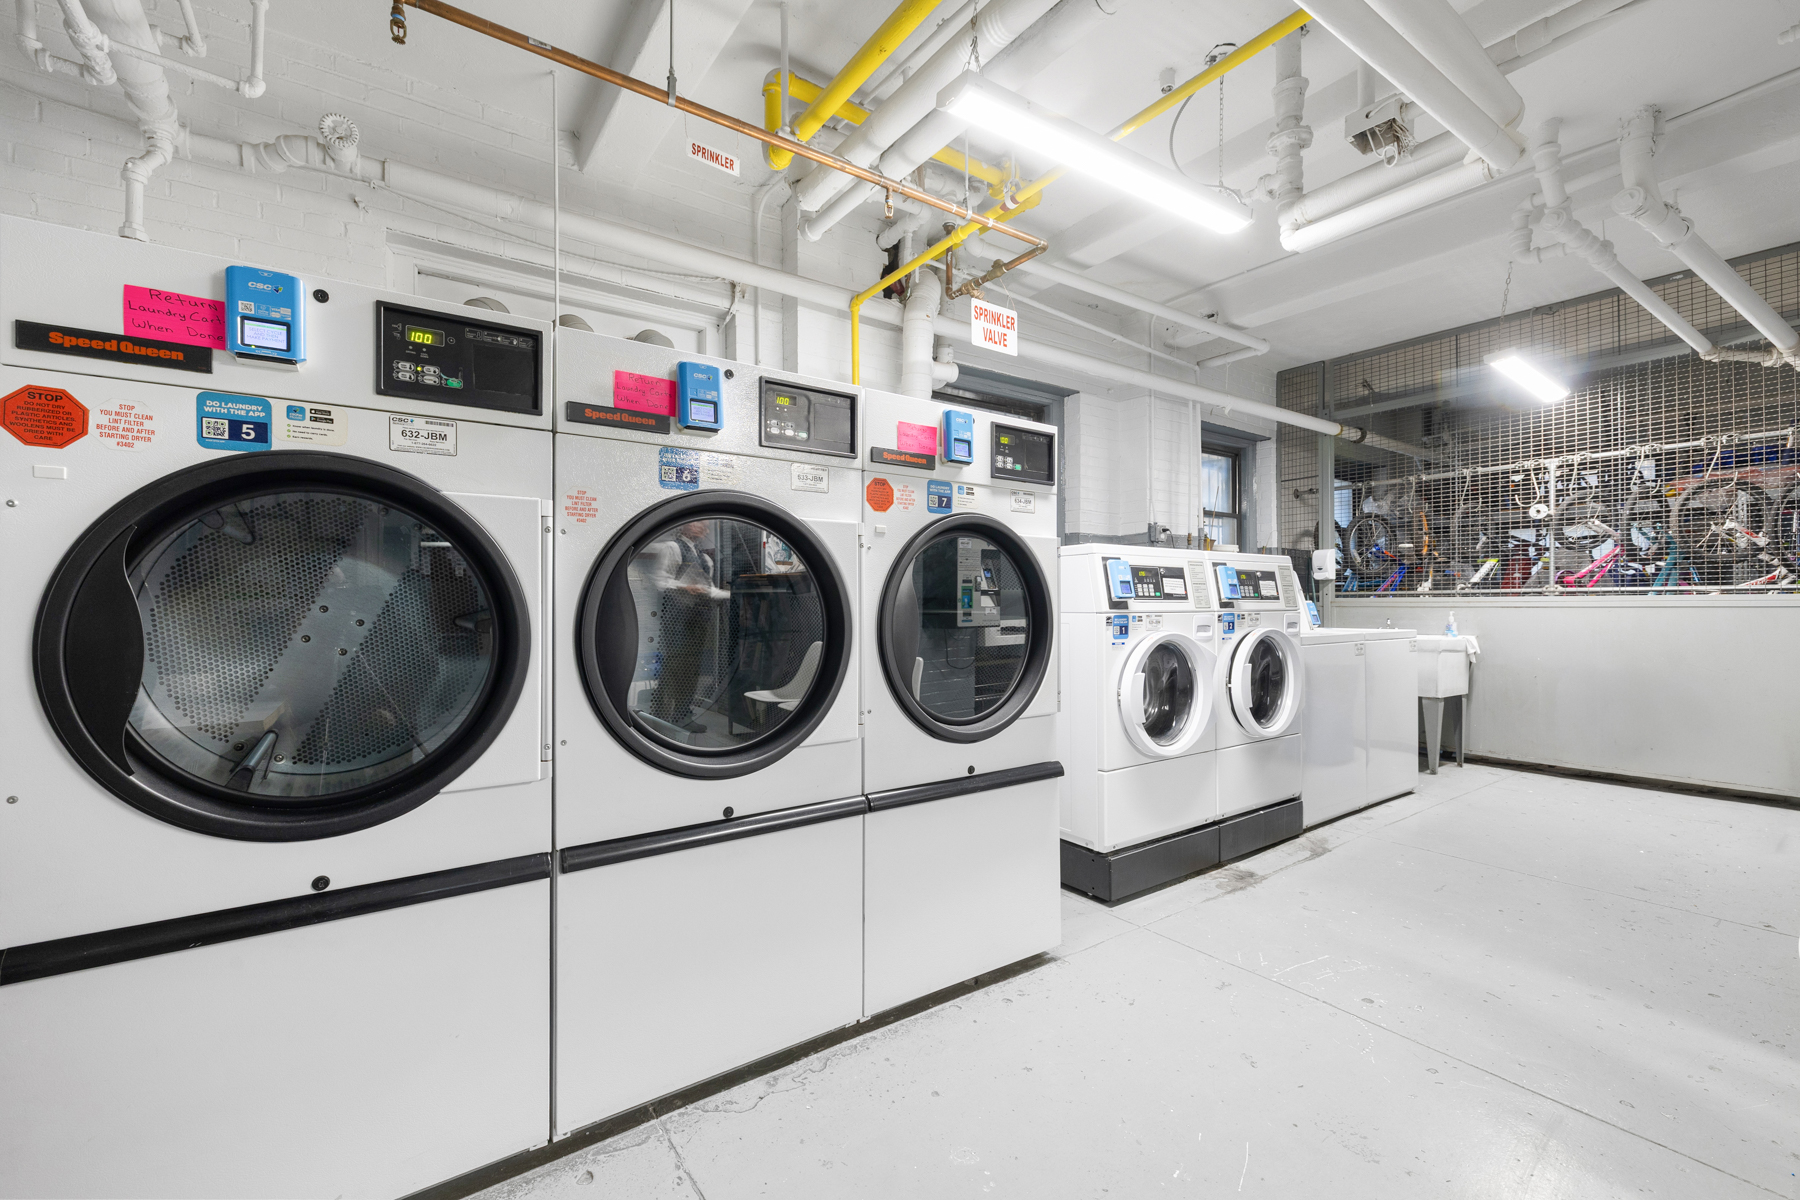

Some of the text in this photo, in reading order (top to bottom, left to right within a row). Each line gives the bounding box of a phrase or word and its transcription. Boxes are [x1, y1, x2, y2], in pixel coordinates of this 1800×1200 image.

[692, 143, 734, 171] SPRINKLER
[248, 282, 272, 290] CSC
[128, 301, 186, 322] Laundry
[974, 305, 1015, 331] SPRINKLER
[132, 318, 224, 342] When Done
[410, 332, 432, 344] 100
[983, 327, 1007, 347] VALVE
[49, 331, 184, 361] Speed Queen
[629, 373, 661, 386] Return
[617, 382, 672, 398] Laundry Carts
[27, 392, 63, 402] STOP
[617, 394, 668, 410] When Done
[776, 396, 789, 405] 100
[16, 406, 60, 414] RUBBERIZED
[222, 402, 263, 411] LAUNDRY
[14, 416, 57, 425] SYNTHETICS
[584, 408, 656, 426] Speed Queen
[9, 421, 44, 429] WOOLENS
[96, 424, 120, 432] BEFORE
[99, 431, 129, 440] STARTING
[241, 424, 256, 440] 5
[401, 430, 447, 441] 632-JBM
[883, 451, 927, 464] Speed Queen
[683, 470, 691, 481] 6
[942, 498, 947, 507] 7
